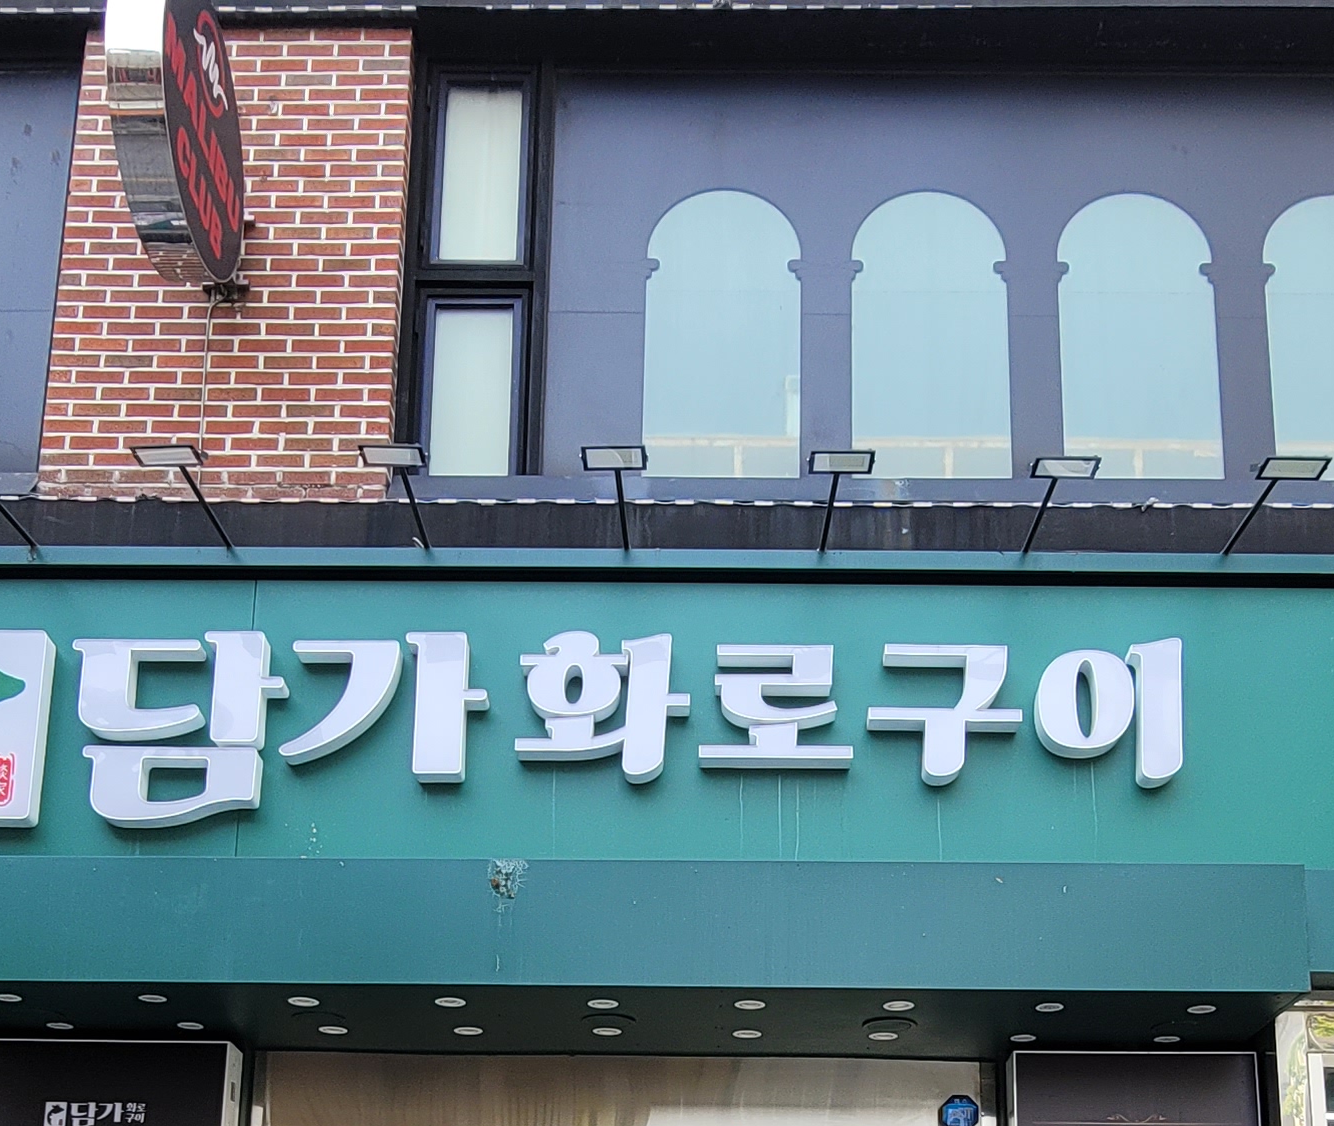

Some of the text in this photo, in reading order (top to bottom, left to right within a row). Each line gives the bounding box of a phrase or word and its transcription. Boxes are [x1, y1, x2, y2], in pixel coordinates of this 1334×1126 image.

[165, 10, 240, 233] MALIBU
[177, 126, 223, 260] CLUB
[124, 1112, 146, 1125] 구이
[125, 1101, 147, 1113] 화로
